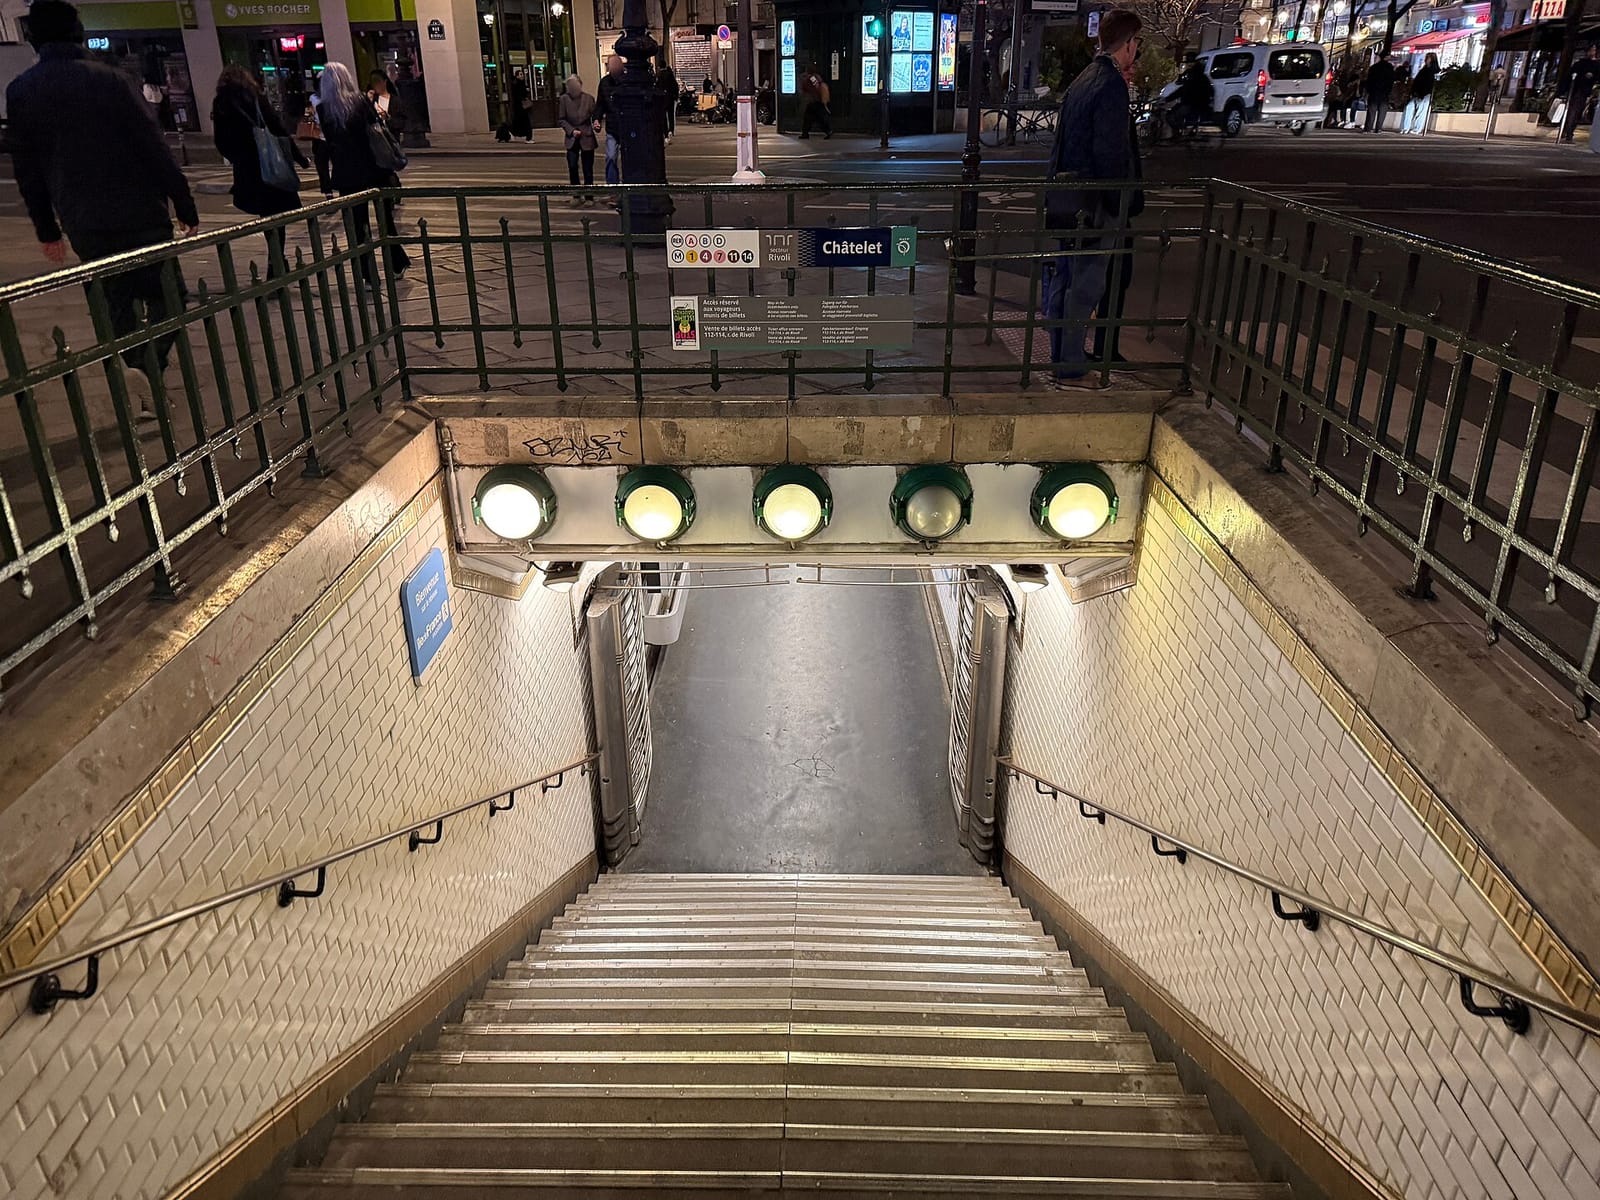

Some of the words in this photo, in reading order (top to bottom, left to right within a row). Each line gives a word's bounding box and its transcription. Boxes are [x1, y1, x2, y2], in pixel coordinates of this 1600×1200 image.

[239, 5, 265, 15] YVES
[267, 4, 310, 14] ROCHER
[1533, 1, 1564, 17] PZZA
[822, 240, 883, 255] Châtelet
[768, 253, 791, 262] Rivoli
